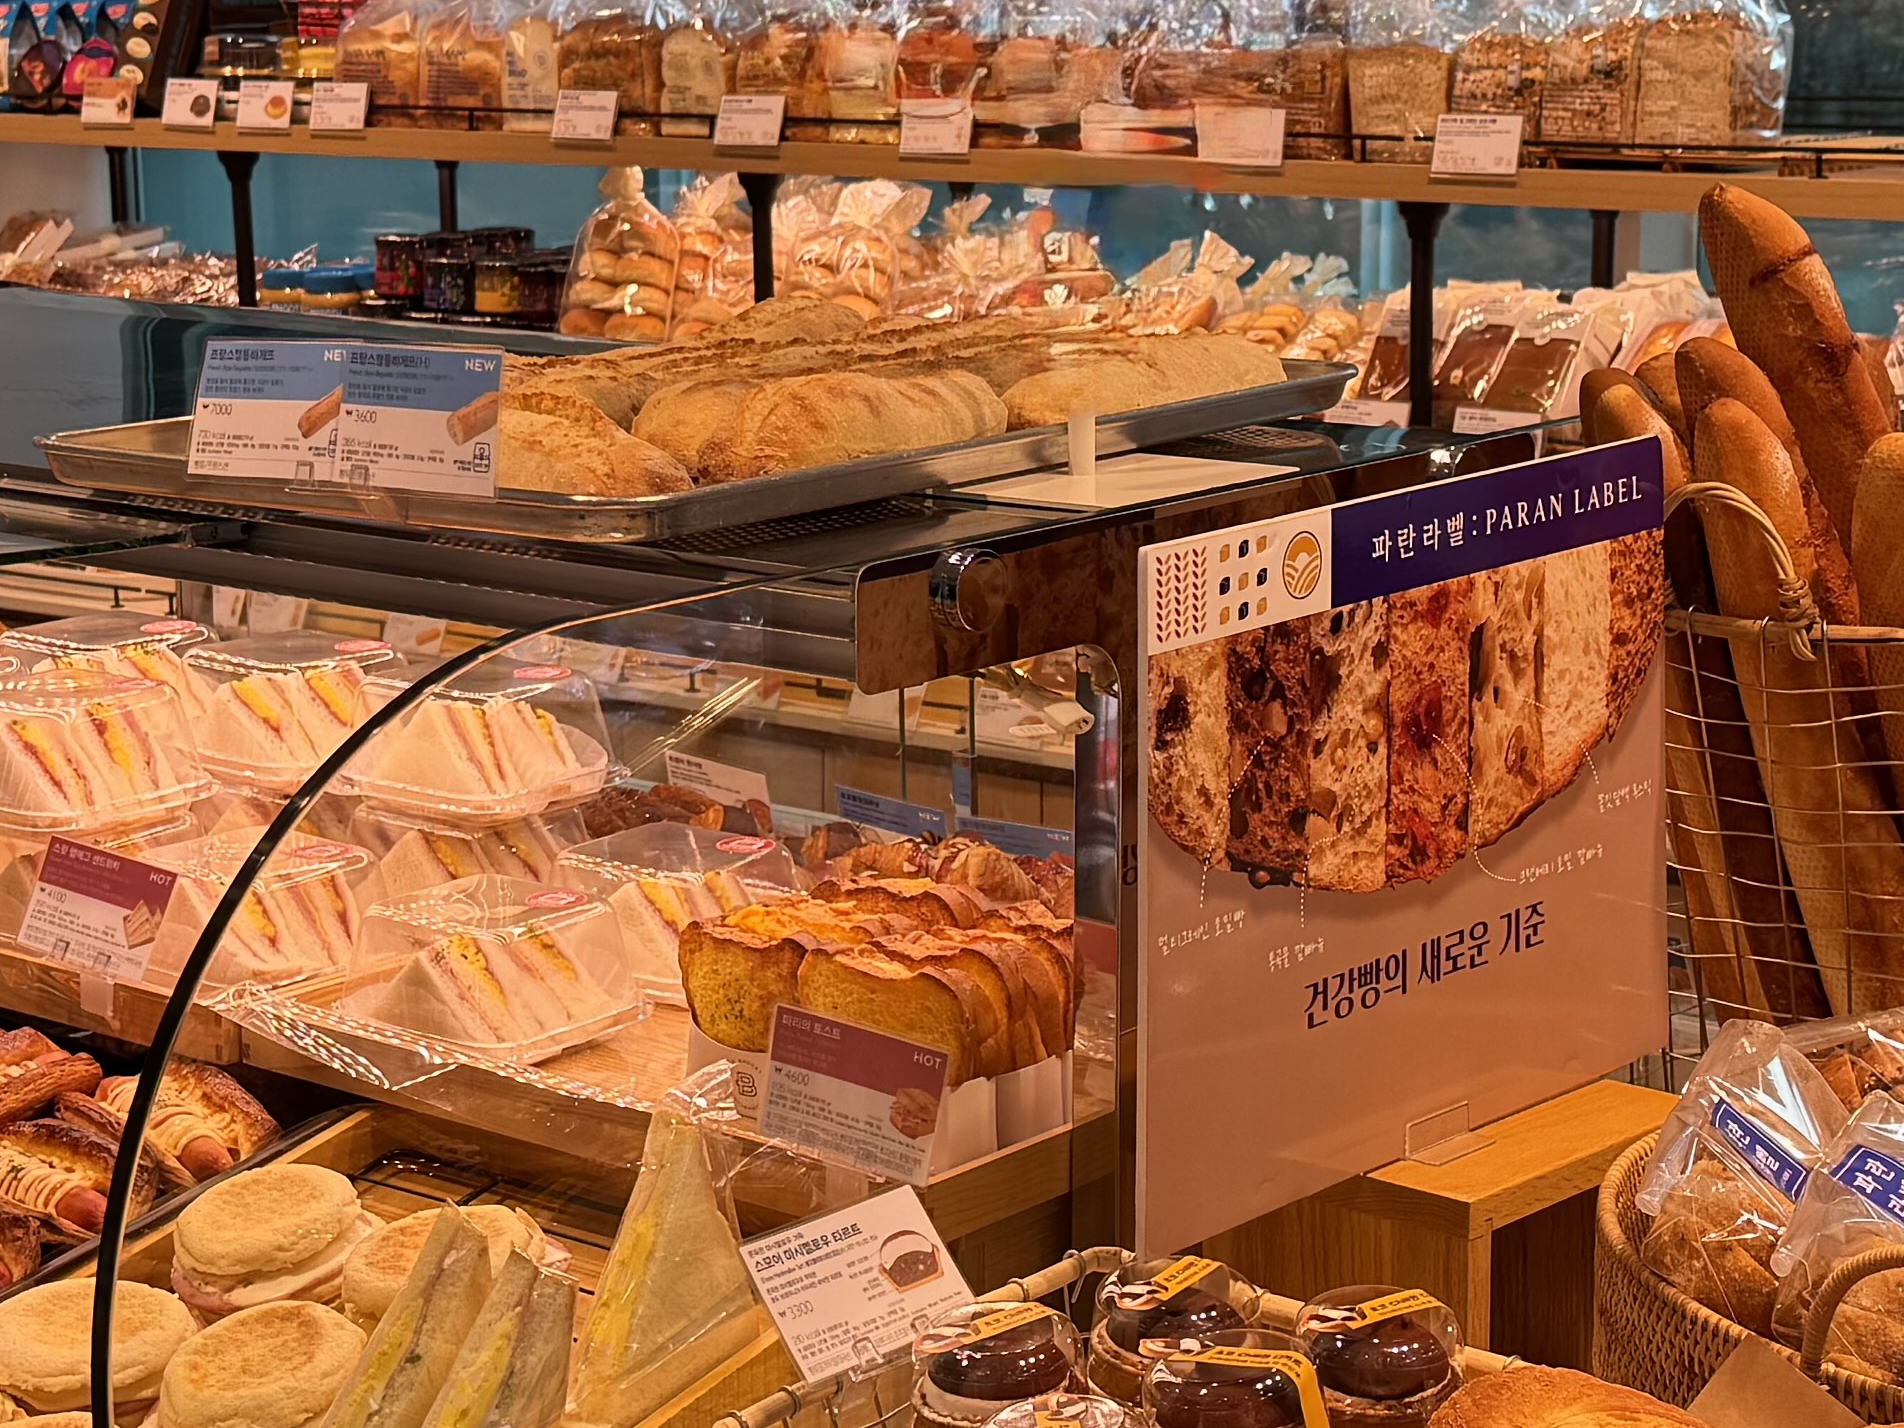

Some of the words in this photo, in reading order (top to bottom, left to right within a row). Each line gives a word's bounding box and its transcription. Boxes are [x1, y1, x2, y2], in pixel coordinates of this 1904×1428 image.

[324, 349, 346, 362] NE
[465, 359, 497, 372] NEW
[1486, 492, 1563, 534] PARAN
[1574, 475, 1642, 515] LABEL
[1304, 948, 1409, 1029] 건강빵의
[1417, 919, 1492, 985] 새로운
[1498, 900, 1547, 956] 기준
[913, 1051, 943, 1069] HOT
[1852, 1157, 1896, 1194] 파란
[755, 1254, 785, 1272] 스모어
[783, 1234, 832, 1261] 마시멜로우
[831, 1222, 863, 1242] 타르트
